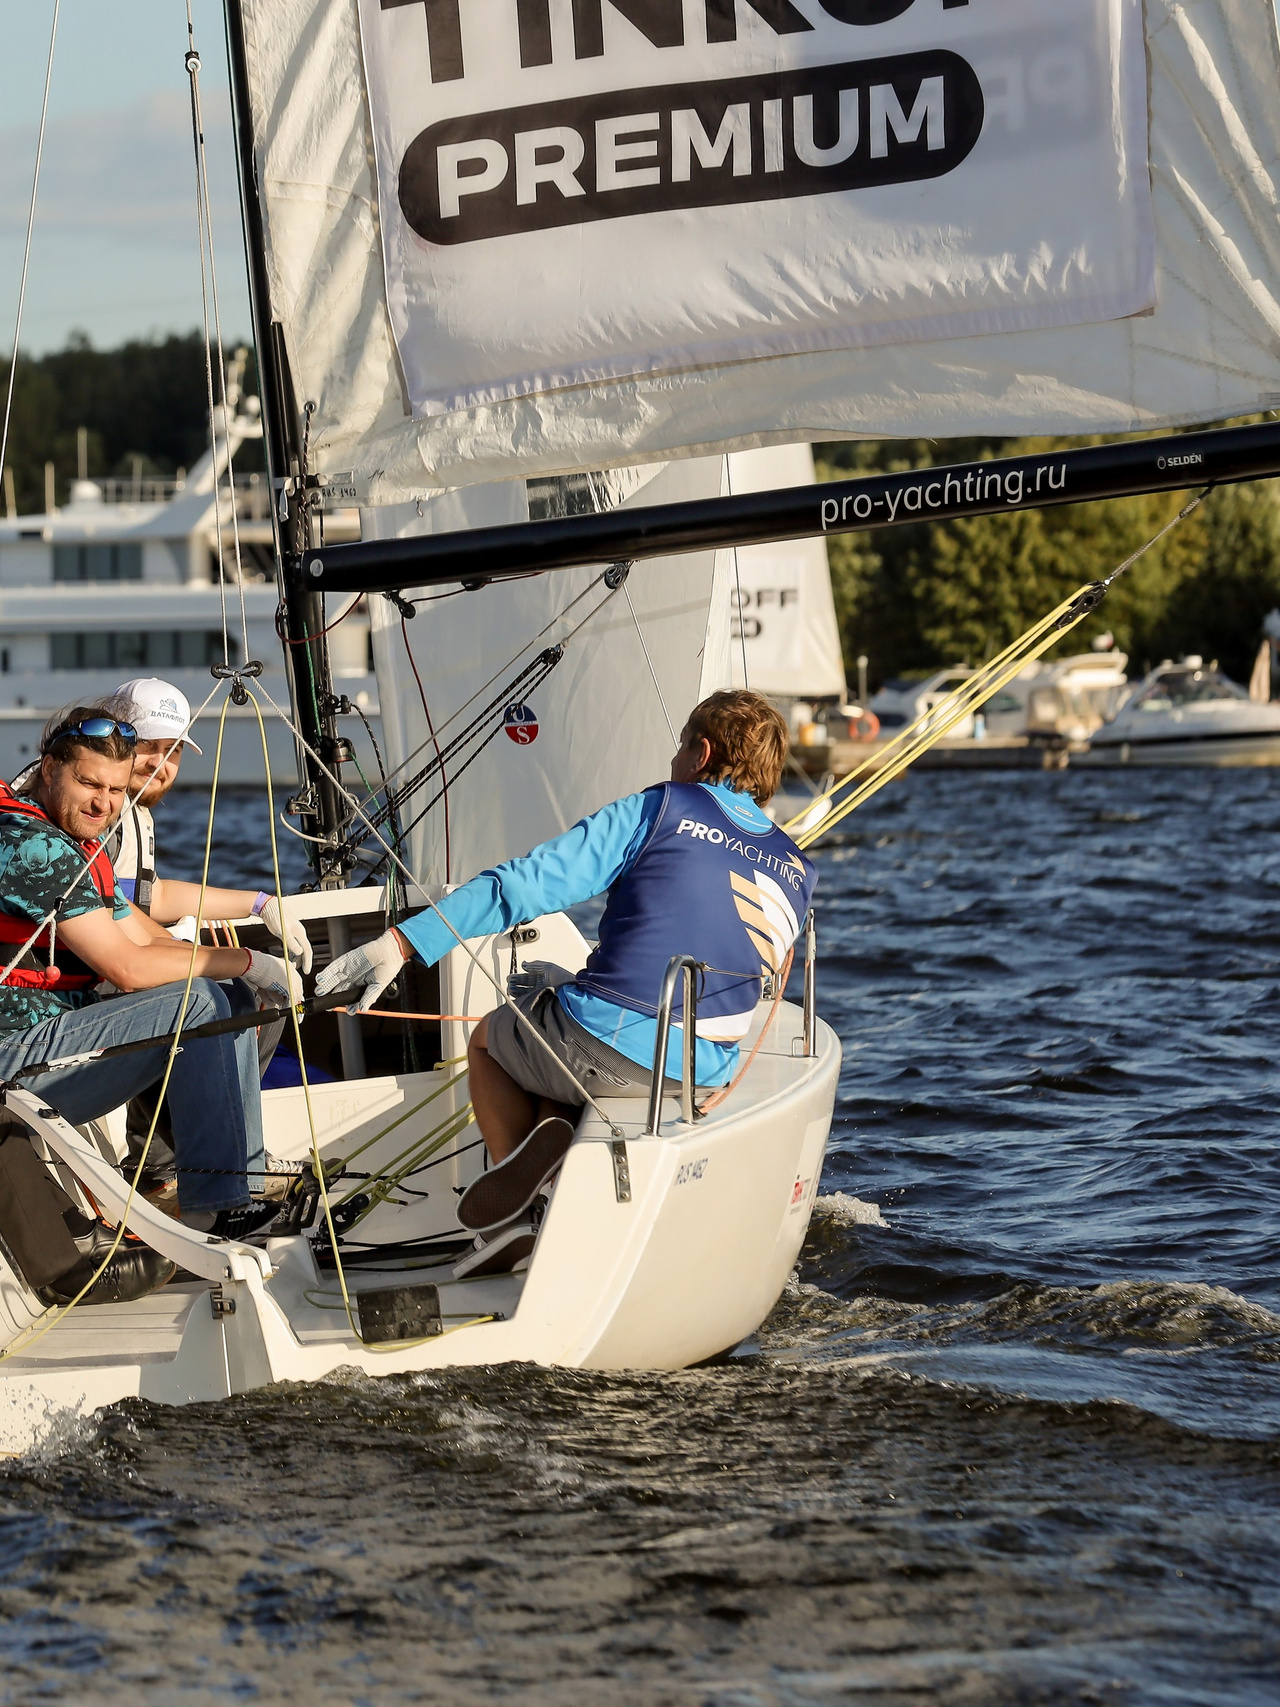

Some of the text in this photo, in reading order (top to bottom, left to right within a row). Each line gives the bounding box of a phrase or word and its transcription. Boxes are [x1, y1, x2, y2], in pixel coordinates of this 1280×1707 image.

[380, 0, 969, 84] TIN
[437, 76, 946, 219] PREMIUM
[820, 463, 1067, 531] pro-yachting.ru
